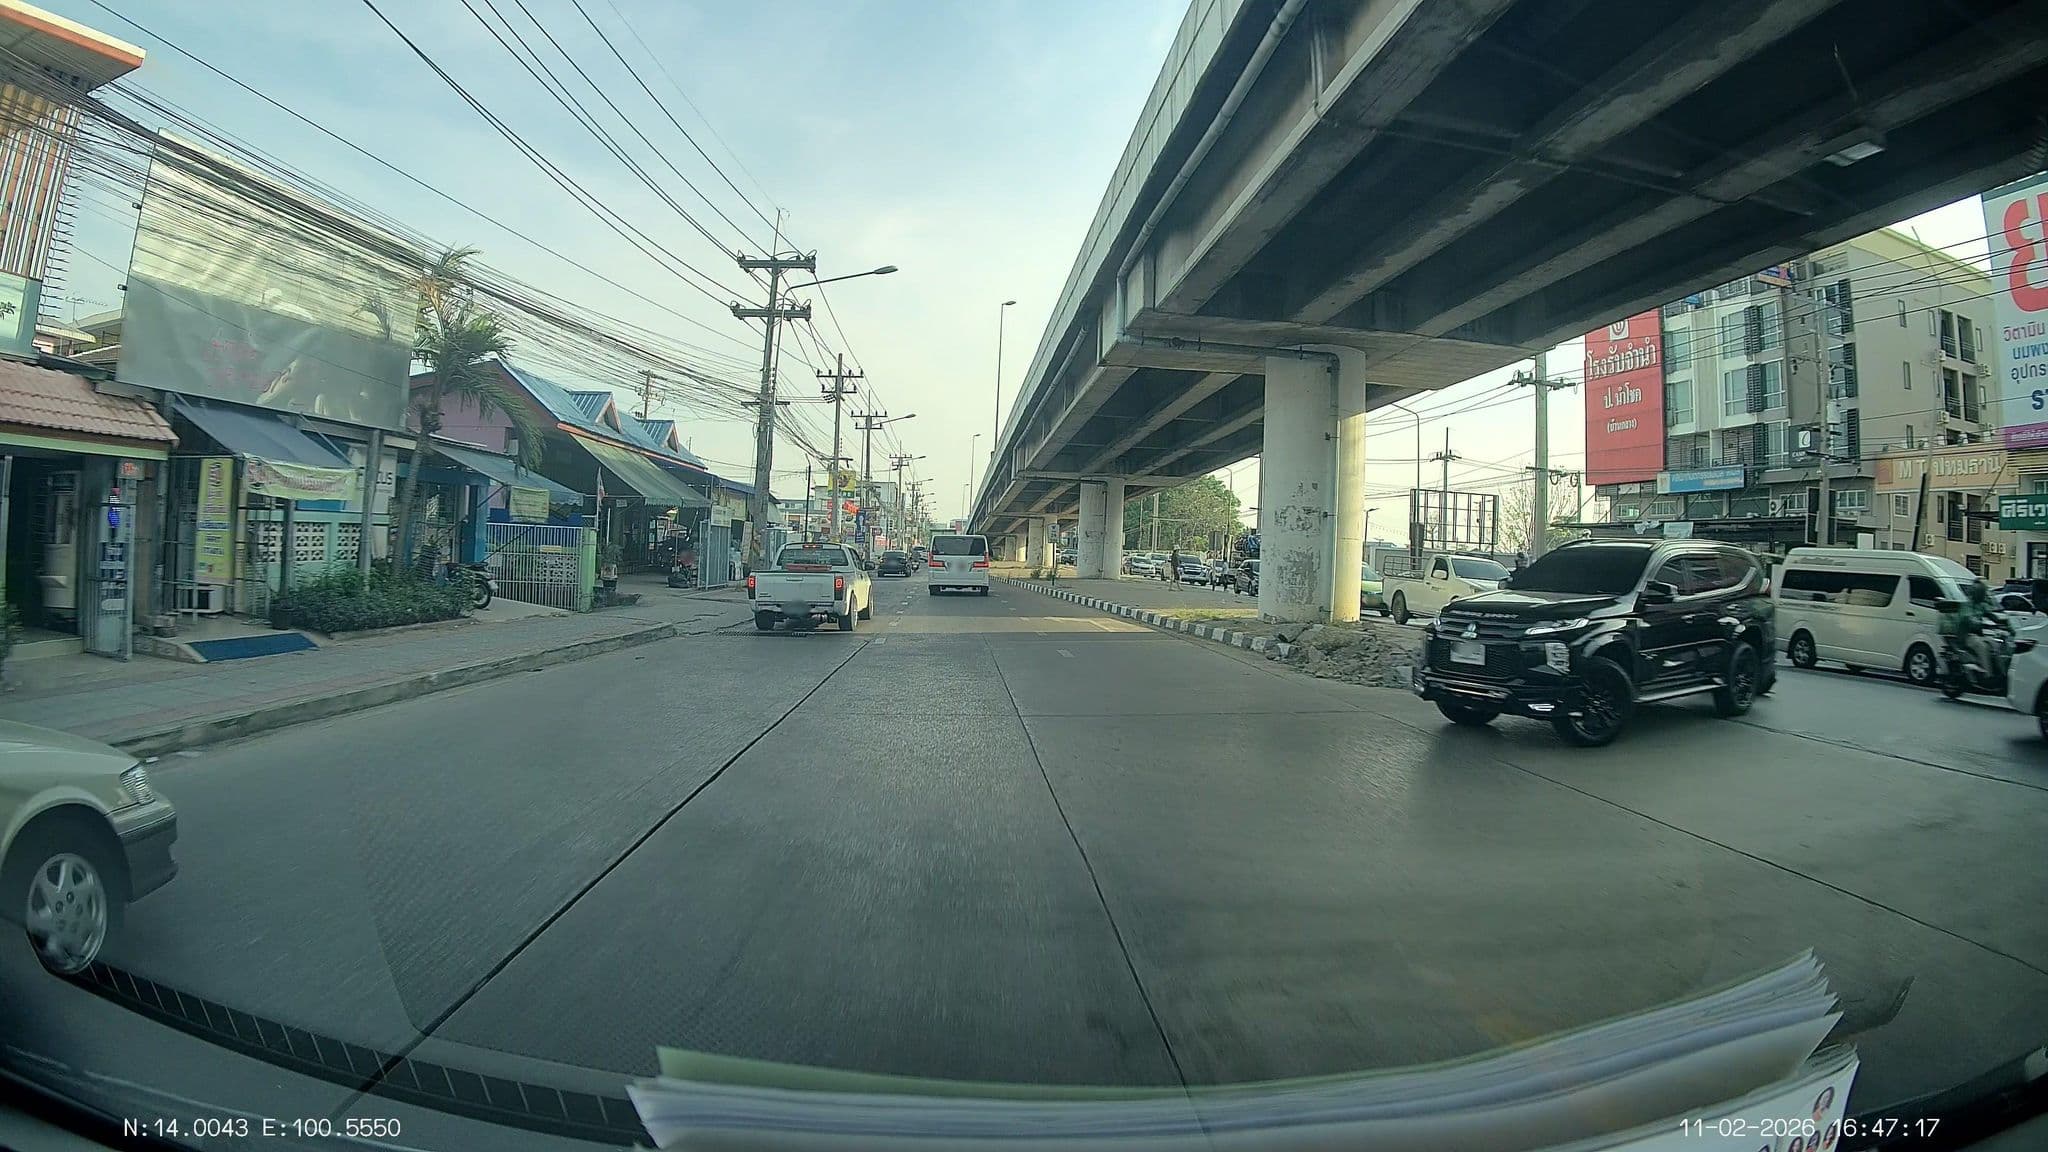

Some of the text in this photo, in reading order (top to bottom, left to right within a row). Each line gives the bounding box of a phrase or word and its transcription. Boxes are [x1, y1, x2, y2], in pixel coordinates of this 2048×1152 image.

[2004, 321, 2045, 341] วิตามิน
[1587, 337, 1656, 380] โรงรับจำนำ
[1933, 452, 2002, 485] ปทุมธานี
